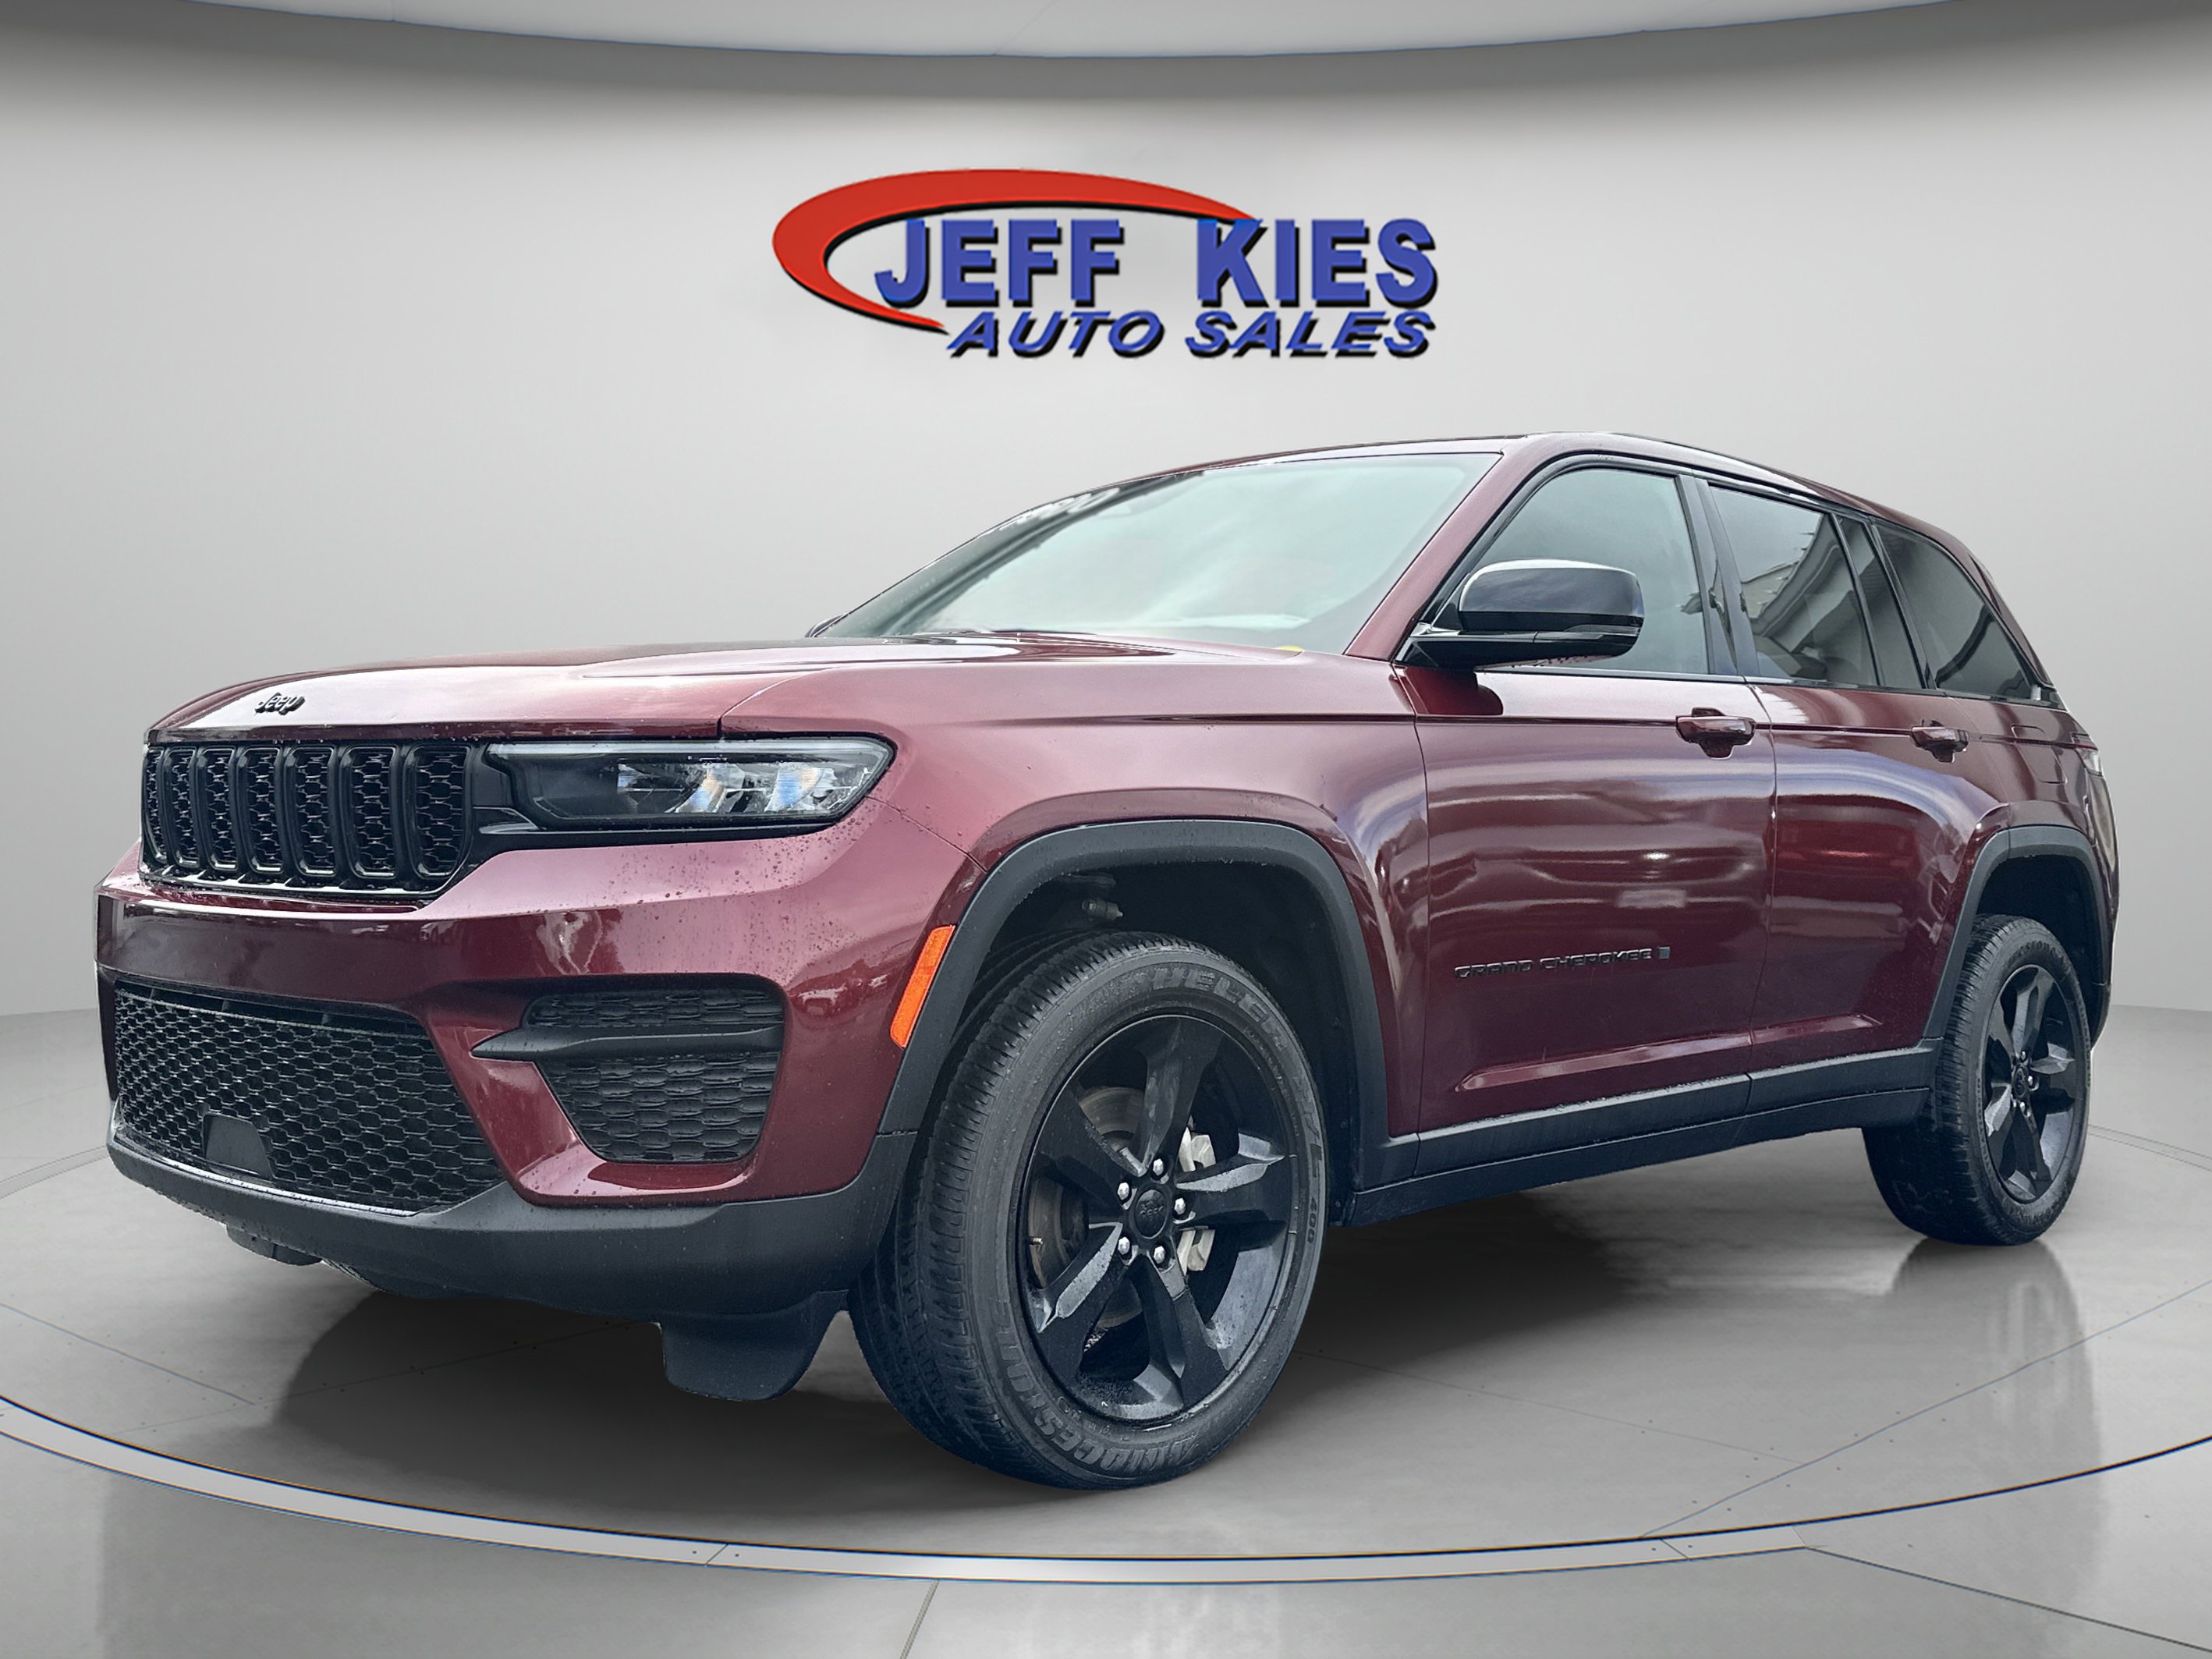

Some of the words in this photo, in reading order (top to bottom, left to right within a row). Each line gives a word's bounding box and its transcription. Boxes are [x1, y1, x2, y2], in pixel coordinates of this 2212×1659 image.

[255, 692, 306, 715] Jeep
[1455, 959, 1533, 978] GRAND
[1540, 948, 1653, 970] CHEROKEE
[1306, 1196, 1318, 1244] 400
